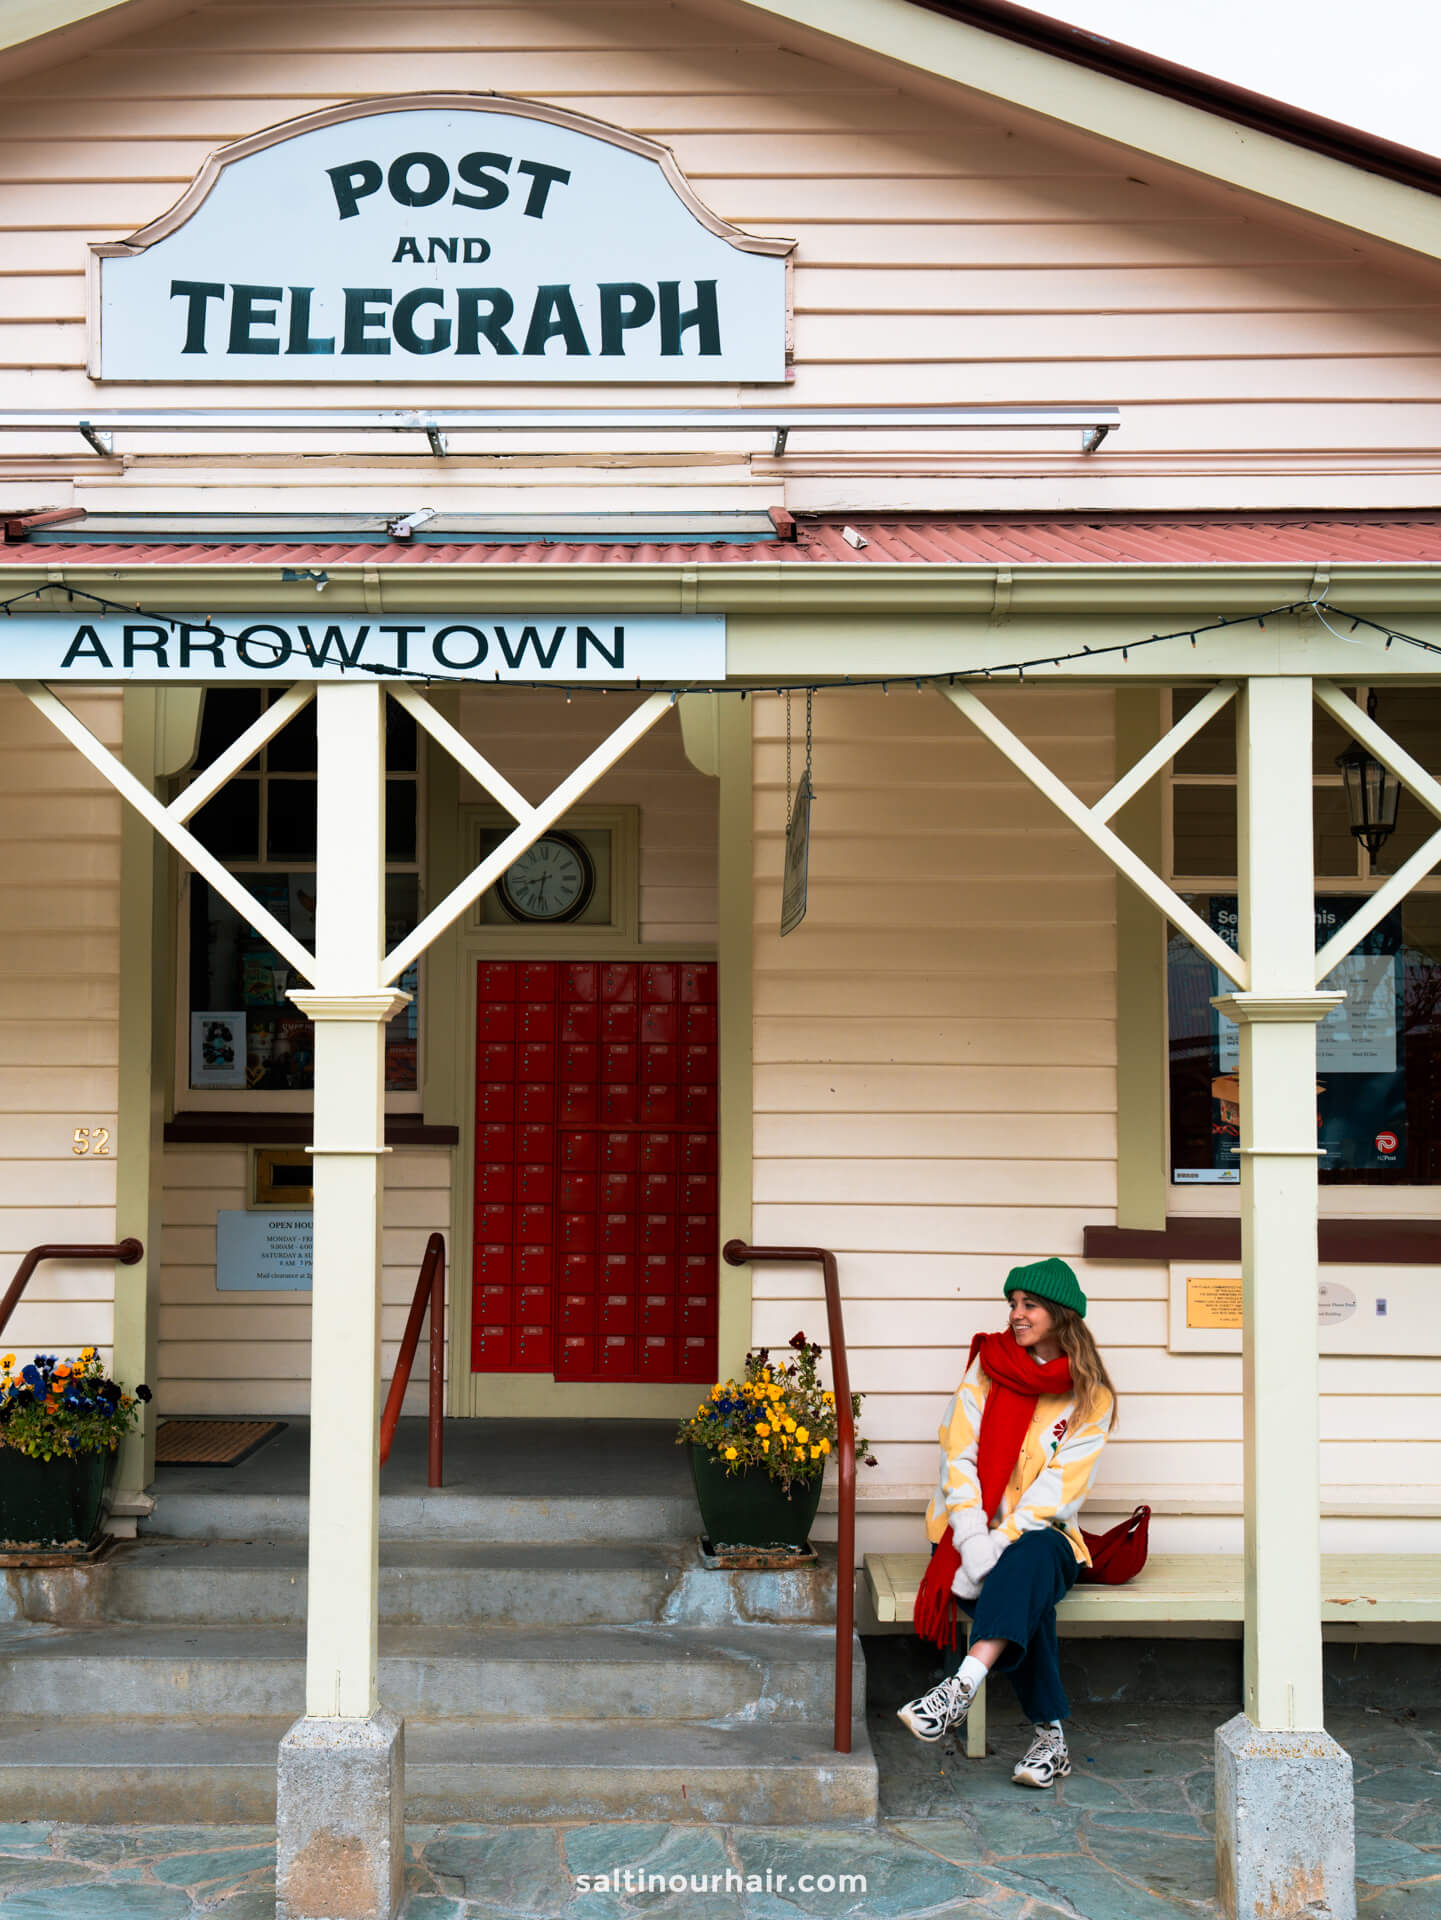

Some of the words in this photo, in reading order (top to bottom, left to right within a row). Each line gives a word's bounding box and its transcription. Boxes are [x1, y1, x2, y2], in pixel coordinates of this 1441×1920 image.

[326, 152, 570, 220] POST
[392, 237, 490, 263] AND
[170, 280, 721, 355] TELEGRAPH
[61, 624, 625, 669] ARROWTOWN
[72, 1127, 110, 1154] 52
[268, 1221, 293, 1229] OPEN
[294, 1221, 313, 1229] HOU
[261, 1251, 297, 1259] SATURDAY
